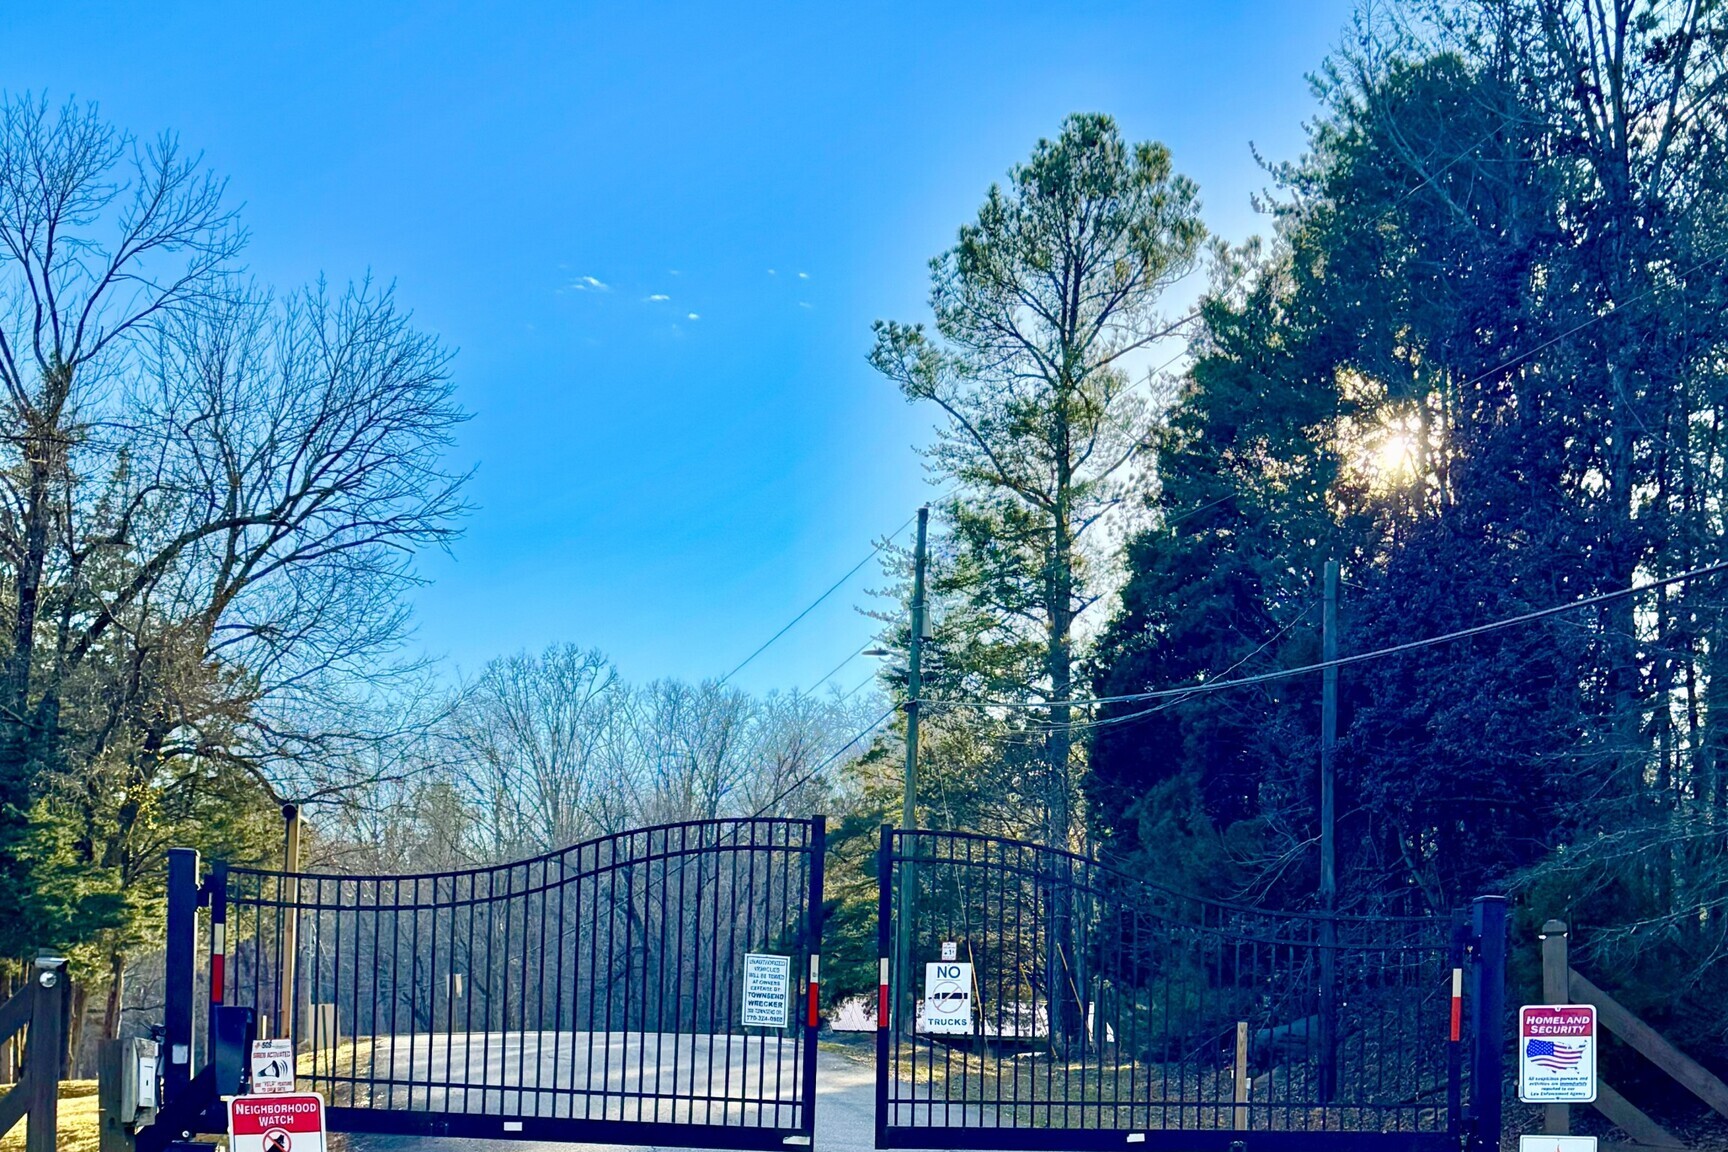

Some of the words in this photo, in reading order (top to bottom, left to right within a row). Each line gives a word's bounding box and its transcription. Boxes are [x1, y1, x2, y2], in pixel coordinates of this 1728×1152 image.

[937, 966, 960, 978] NO
[1526, 1016, 1590, 1024] HOMELAND
[236, 1103, 316, 1115] NEIGHBORHOOD
[259, 1116, 294, 1126] WATCH
